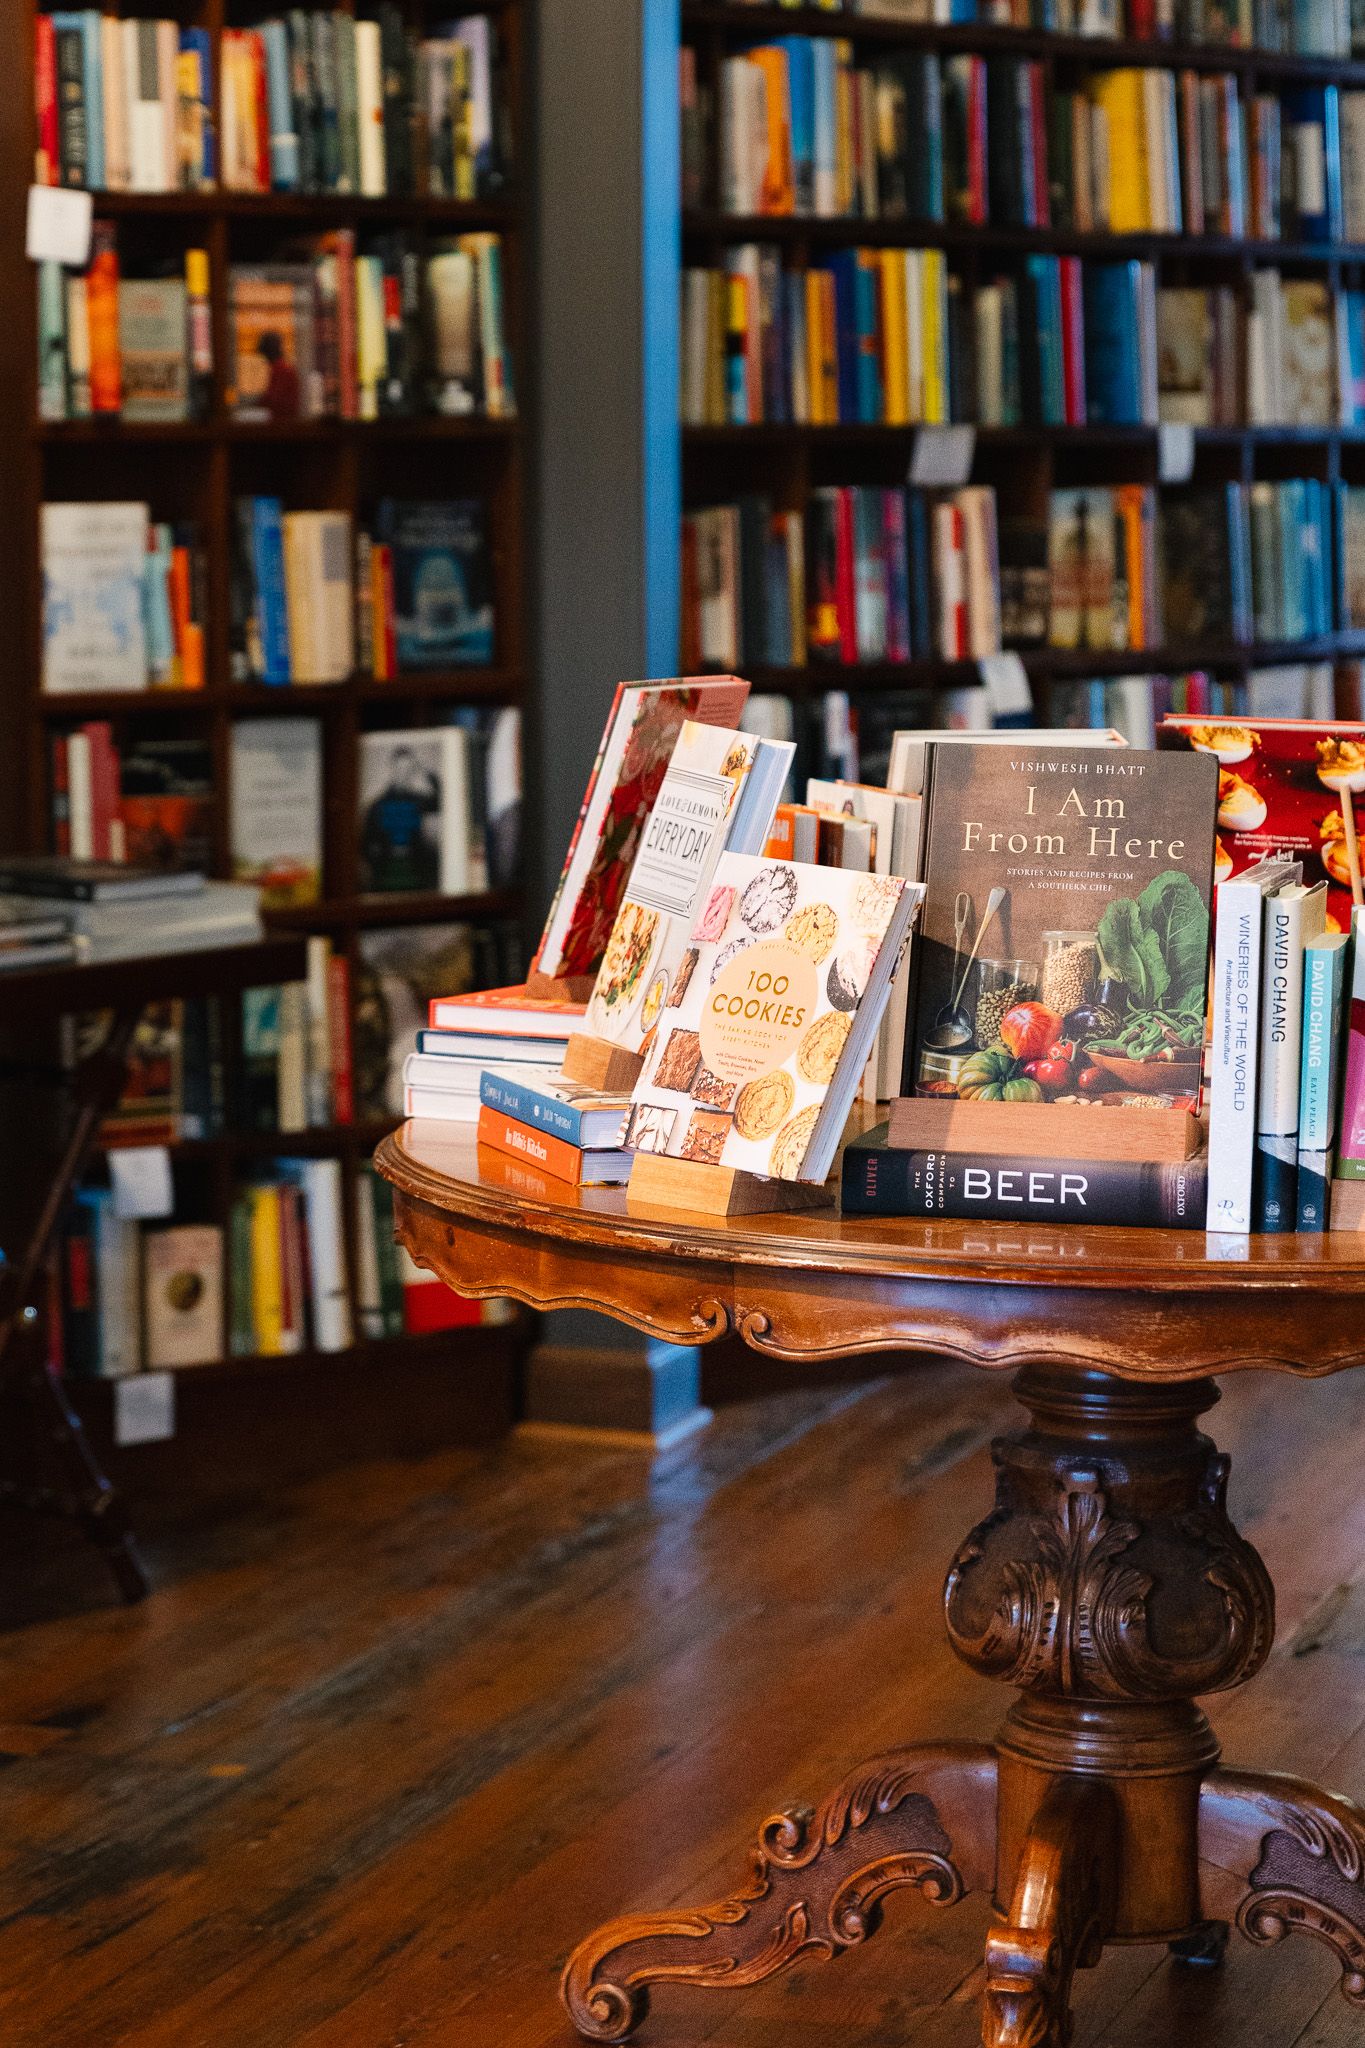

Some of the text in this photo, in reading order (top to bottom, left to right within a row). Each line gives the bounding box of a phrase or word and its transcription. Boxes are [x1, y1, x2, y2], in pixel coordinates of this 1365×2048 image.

[1010, 761, 1146, 776] VISHWESH BHATT
[660, 794, 681, 810] LOVE
[1025, 786, 1126, 818] I Am
[682, 828, 712, 864] DAY
[961, 822, 1185, 860] From Here
[1006, 868, 1044, 876] STORIES
[1069, 870, 1106, 879] RECIPES
[1108, 872, 1134, 880] FROM
[1037, 882, 1087, 890] SOUTHERN
[1089, 884, 1113, 892] CHEF
[747, 970, 790, 996] 100
[1224, 959, 1233, 1007] Architecture
[1271, 915, 1290, 1042] DAVID CHANG
[712, 993, 806, 1028] COOKIES
[1233, 915, 1250, 1112] WINERIES OF THE WORLD
[1308, 960, 1325, 1068] DAVID CHANG
[1222, 1024, 1231, 1065] Viniculture
[1310, 1077, 1318, 1094] EAT
[866, 1157, 879, 1197] OLIVER
[925, 1153, 936, 1208] OXFORD
[938, 1154, 946, 1208] COMPANION
[950, 1176, 956, 1188] TO
[963, 1168, 1088, 1205] BEER
[1177, 1174, 1186, 1216] OXFORD
